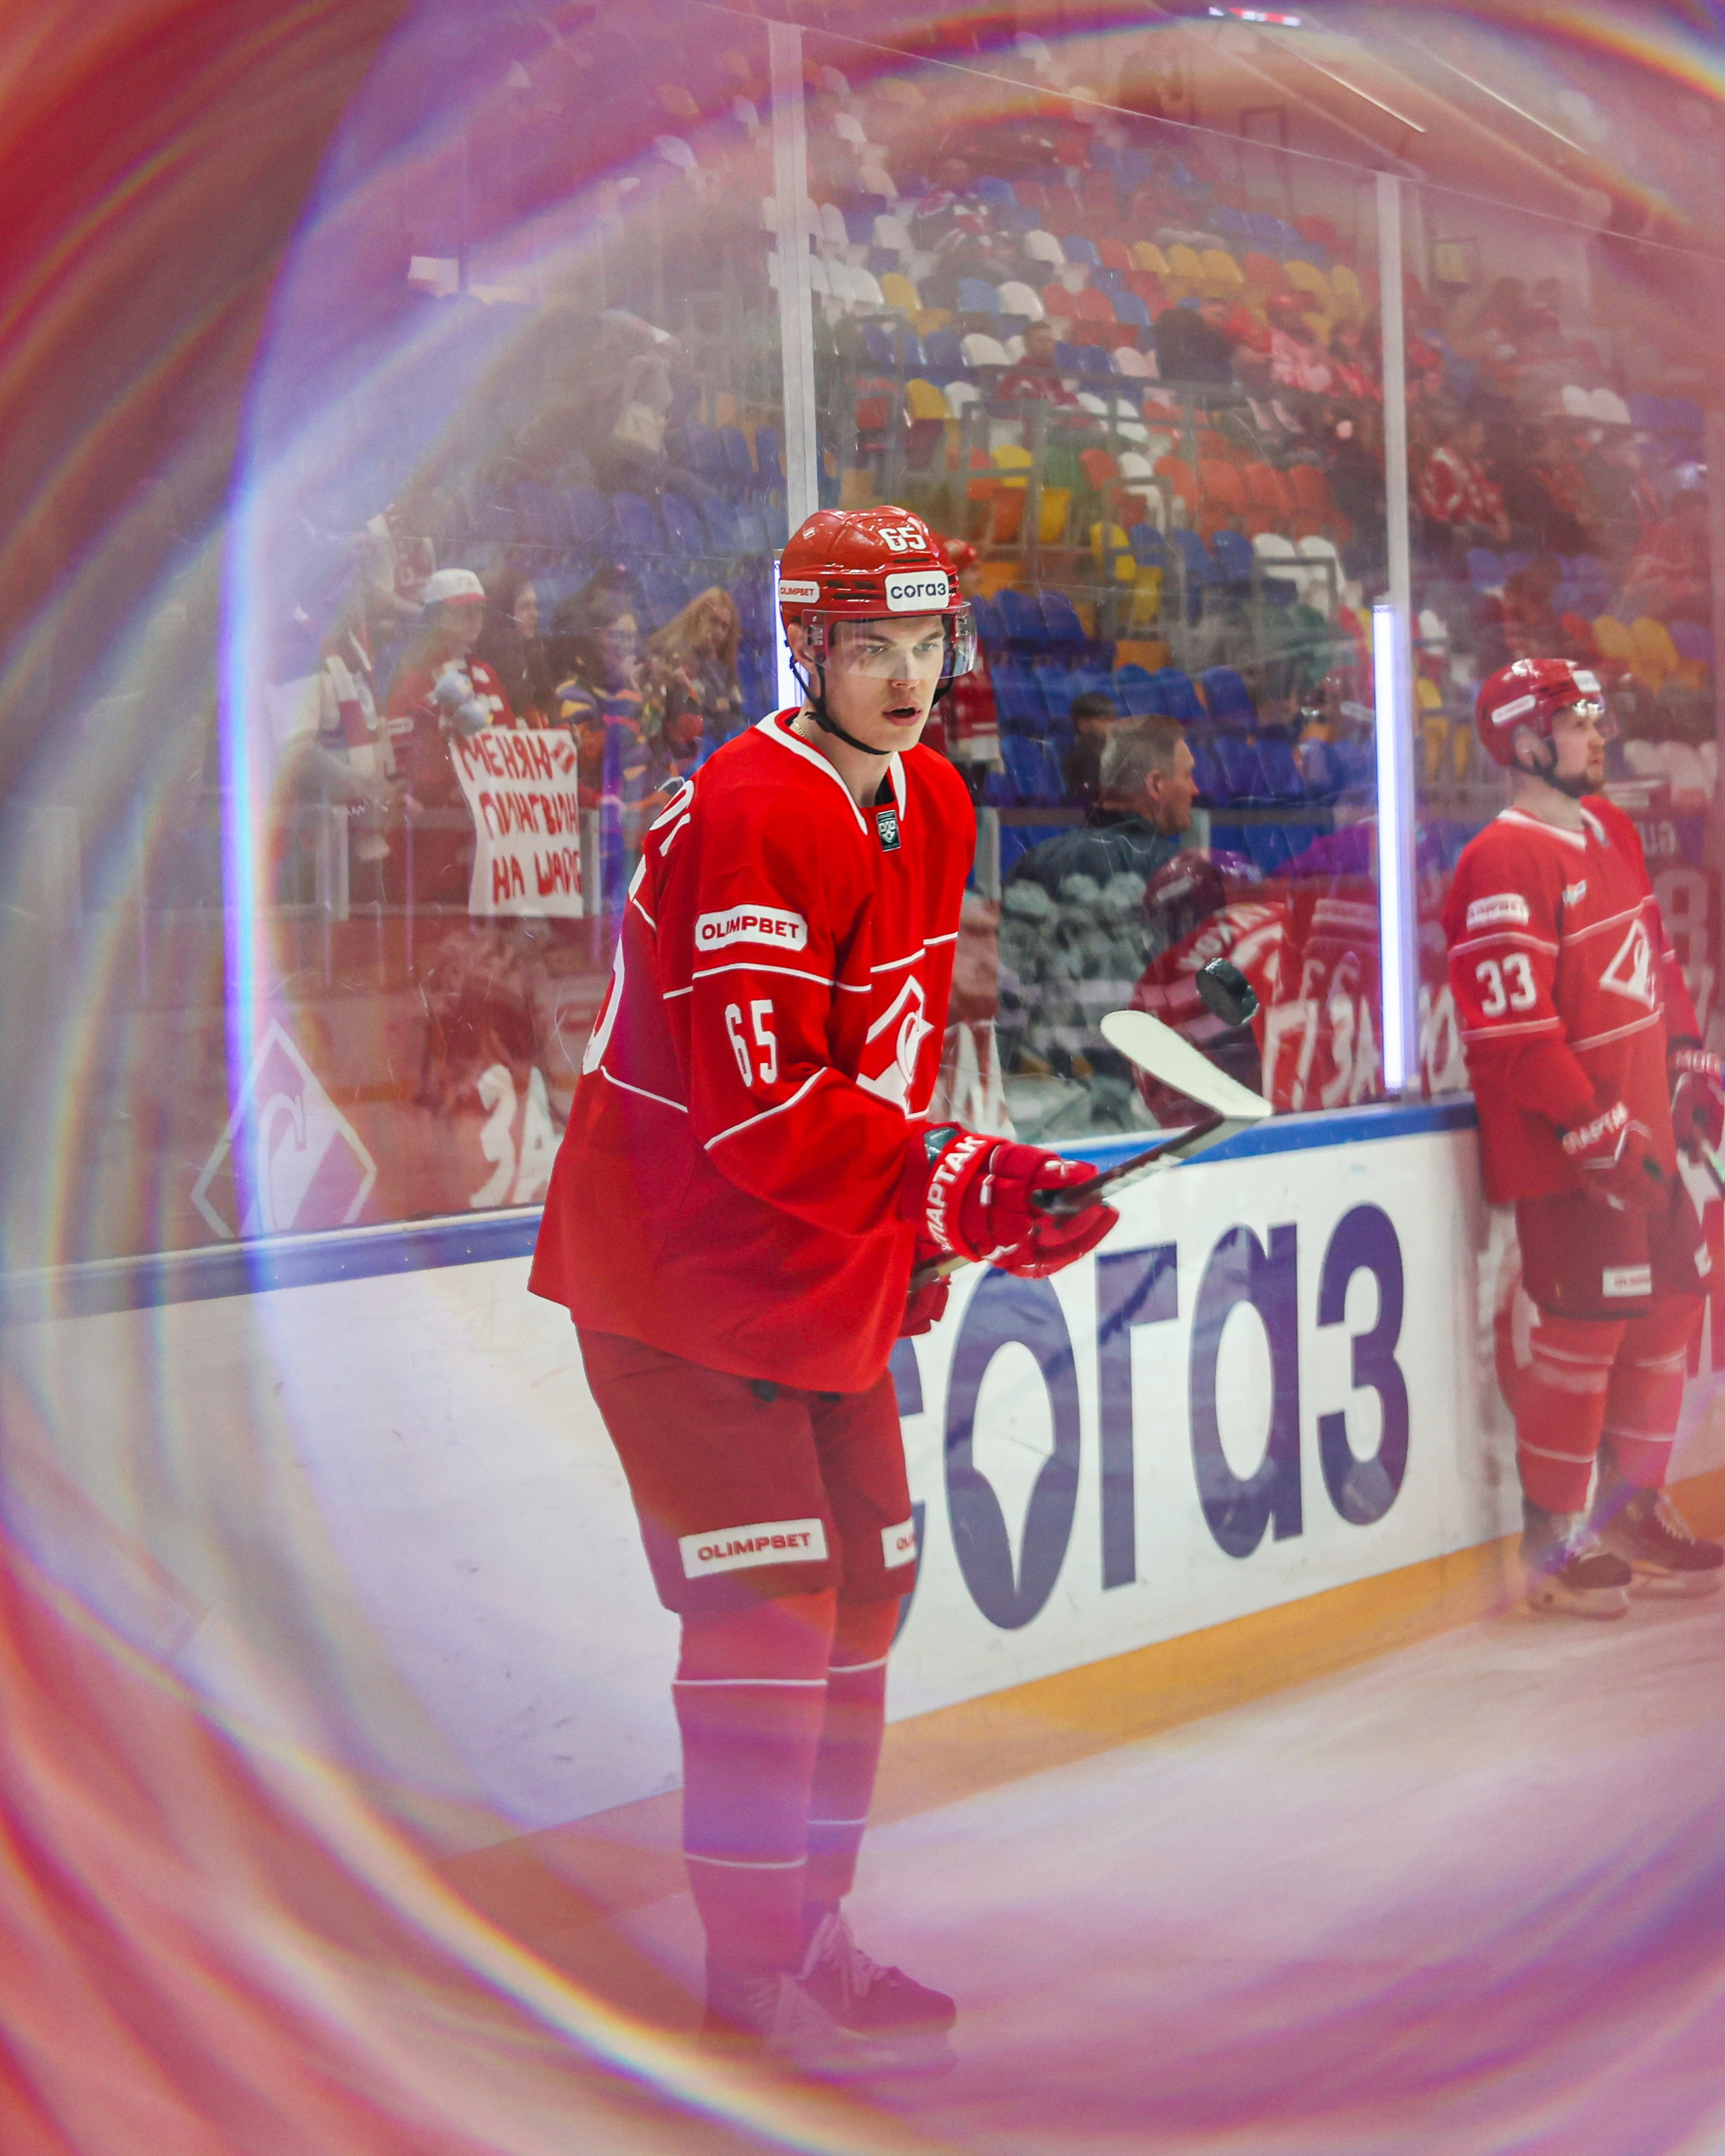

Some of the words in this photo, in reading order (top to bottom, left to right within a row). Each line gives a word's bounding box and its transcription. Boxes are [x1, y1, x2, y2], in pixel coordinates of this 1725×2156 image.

[878, 527, 927, 552] 65
[780, 587, 815, 597] OLIMPBET
[493, 854, 526, 905] НА
[701, 916, 800, 941] OLIMPBET
[1476, 952, 1537, 1017] 33
[724, 999, 778, 1087] 65
[697, 1531, 811, 1561] OLIMPBET
